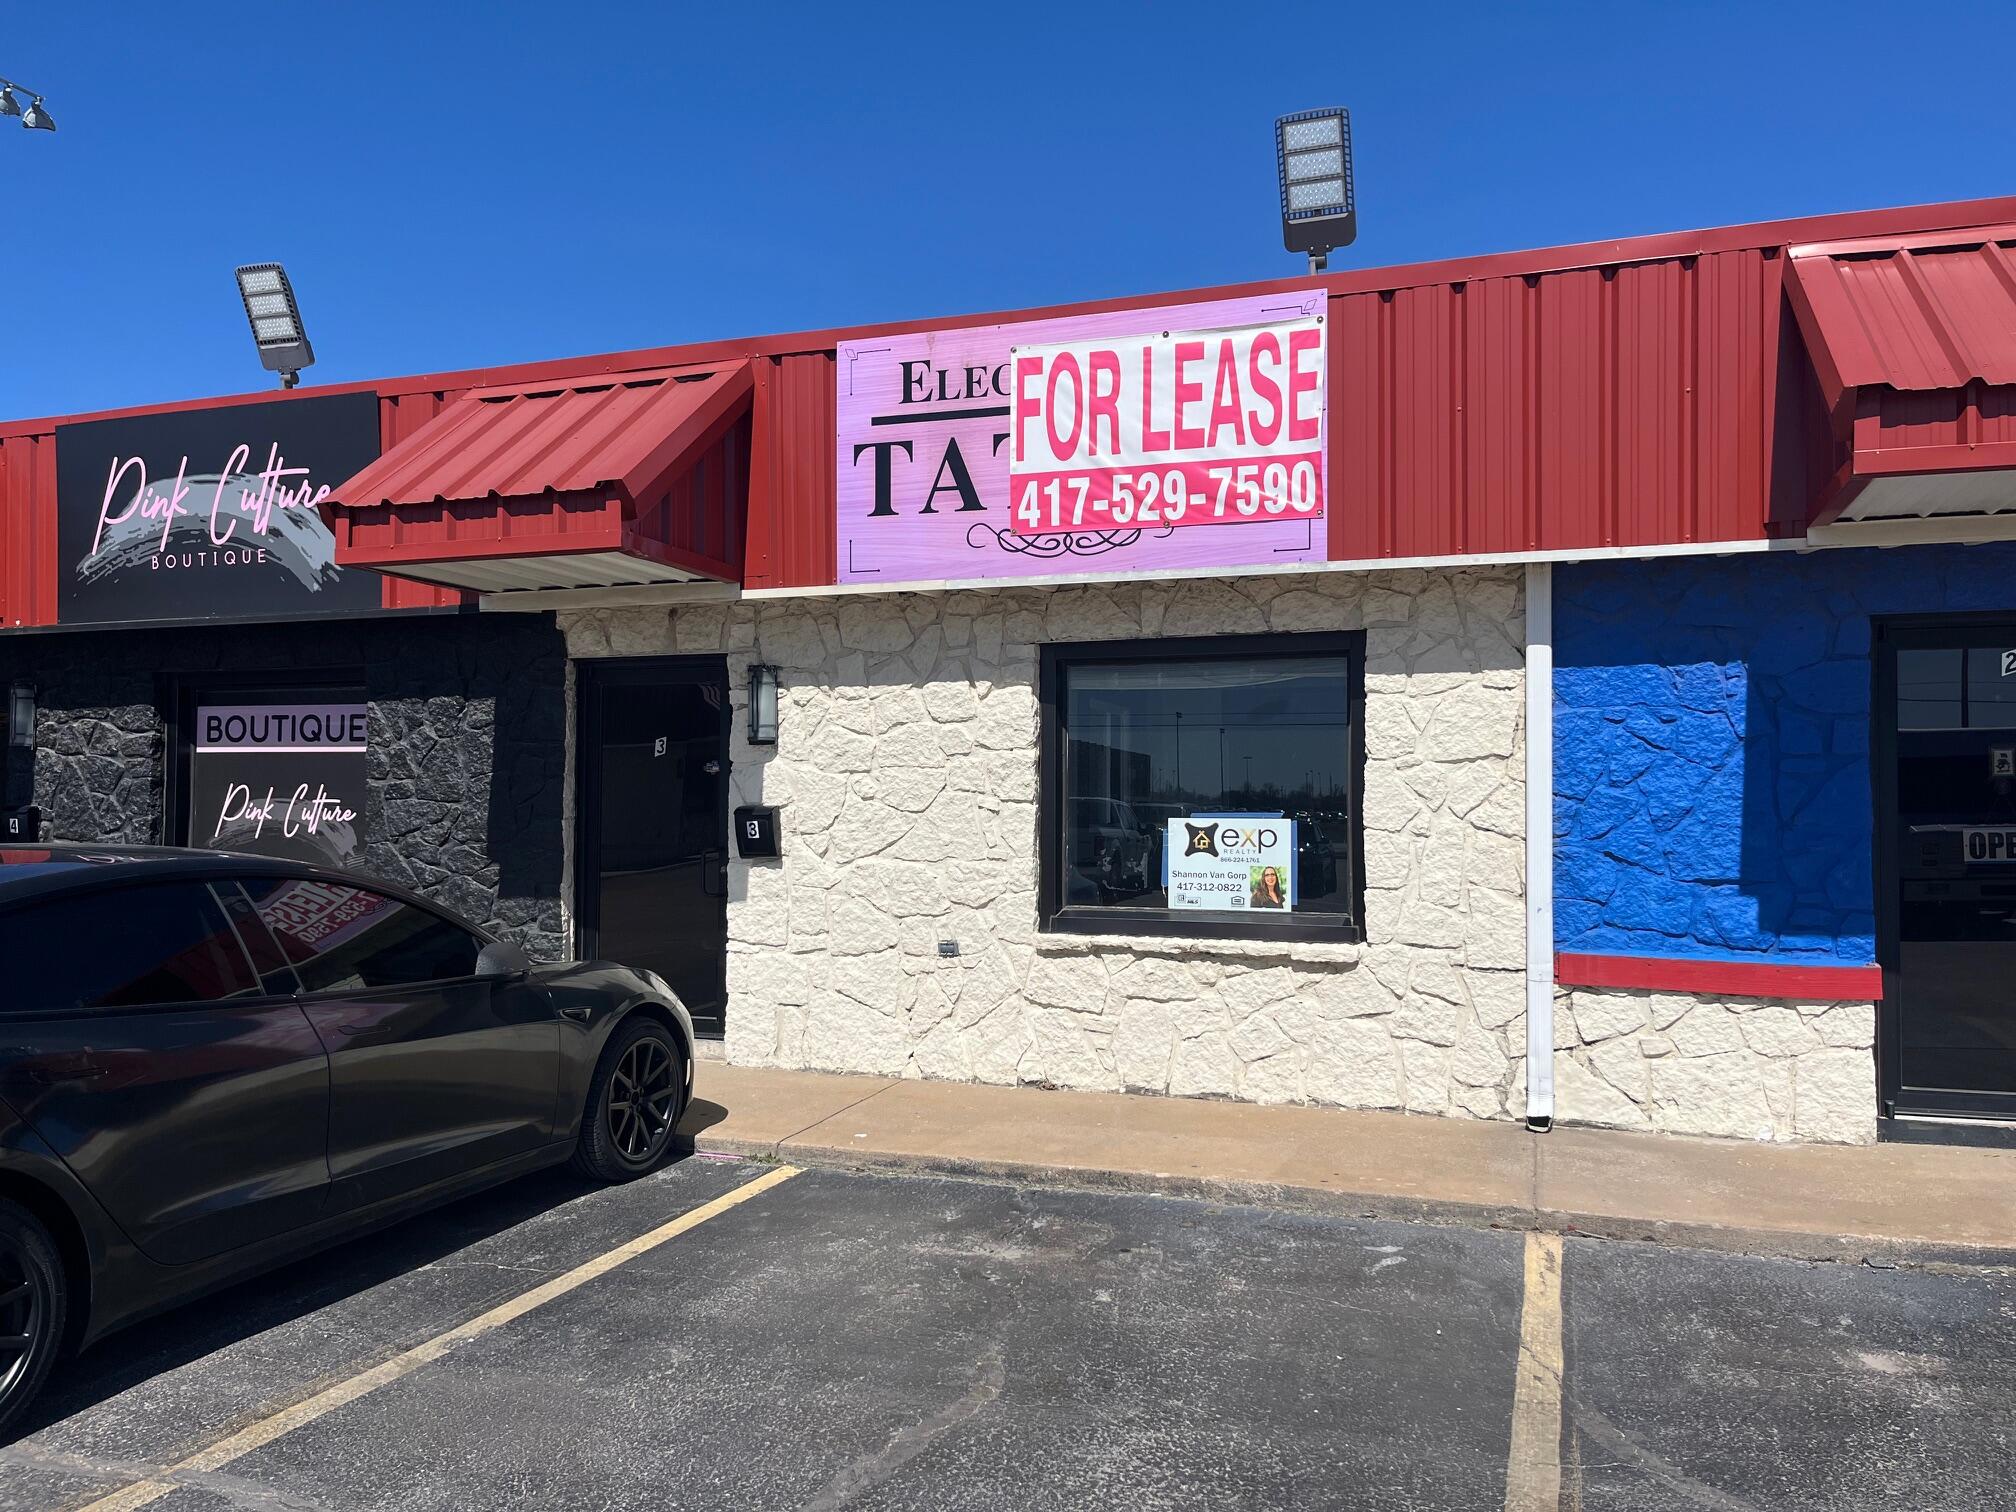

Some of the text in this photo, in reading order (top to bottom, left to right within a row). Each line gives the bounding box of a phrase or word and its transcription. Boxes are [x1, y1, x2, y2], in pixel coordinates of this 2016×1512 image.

[1015, 328, 1321, 462] FOR LEASE
[91, 441, 331, 556] Pink Culture
[1016, 461, 1317, 529] 417-529-7590
[151, 548, 267, 570] BOUTIQUE
[2005, 652, 2016, 674] 2
[206, 714, 367, 743] BOUTIQUE
[656, 739, 665, 754] 3
[214, 783, 357, 839] Pink Culture
[11, 820, 17, 831] 4
[748, 822, 758, 837] 3
[1221, 828, 1278, 854] exp
[1172, 870, 1247, 881] Shannon Van Gorp
[1176, 882, 1242, 892] 417-312-0822
